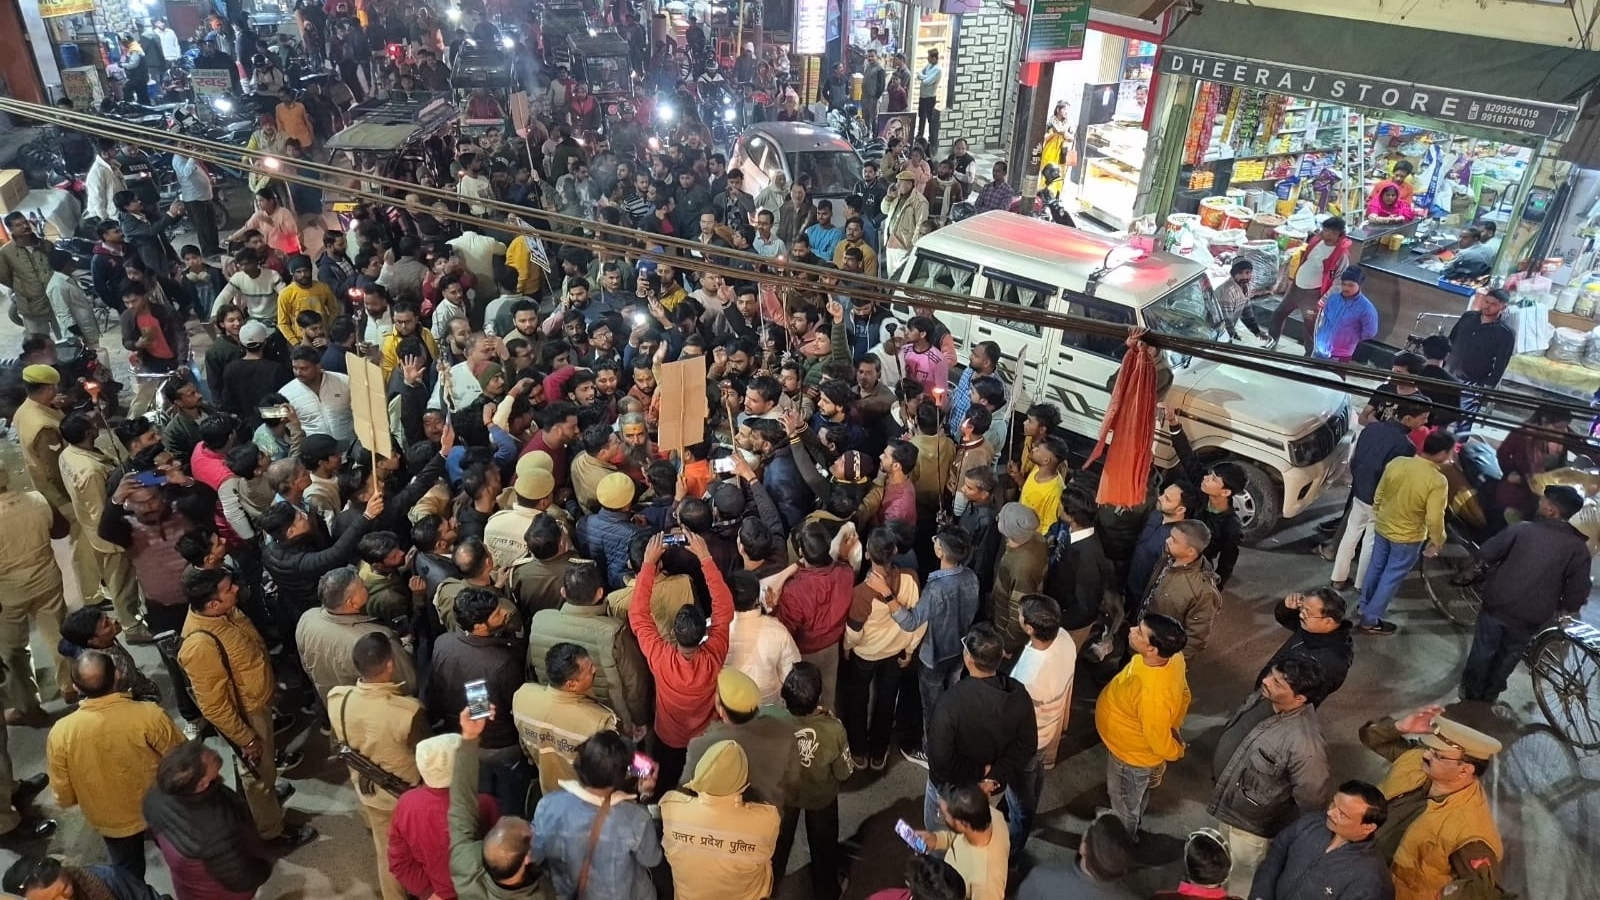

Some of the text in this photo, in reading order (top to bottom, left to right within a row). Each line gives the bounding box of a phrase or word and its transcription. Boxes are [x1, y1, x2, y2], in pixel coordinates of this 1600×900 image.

[1170, 56, 1459, 116] DHEERAJ STORE
[1481, 112, 1536, 129] 9918178109
[1485, 103, 1540, 119] 8299544319
[671, 830, 757, 854] उत्तर प्रदेश पुलिस
